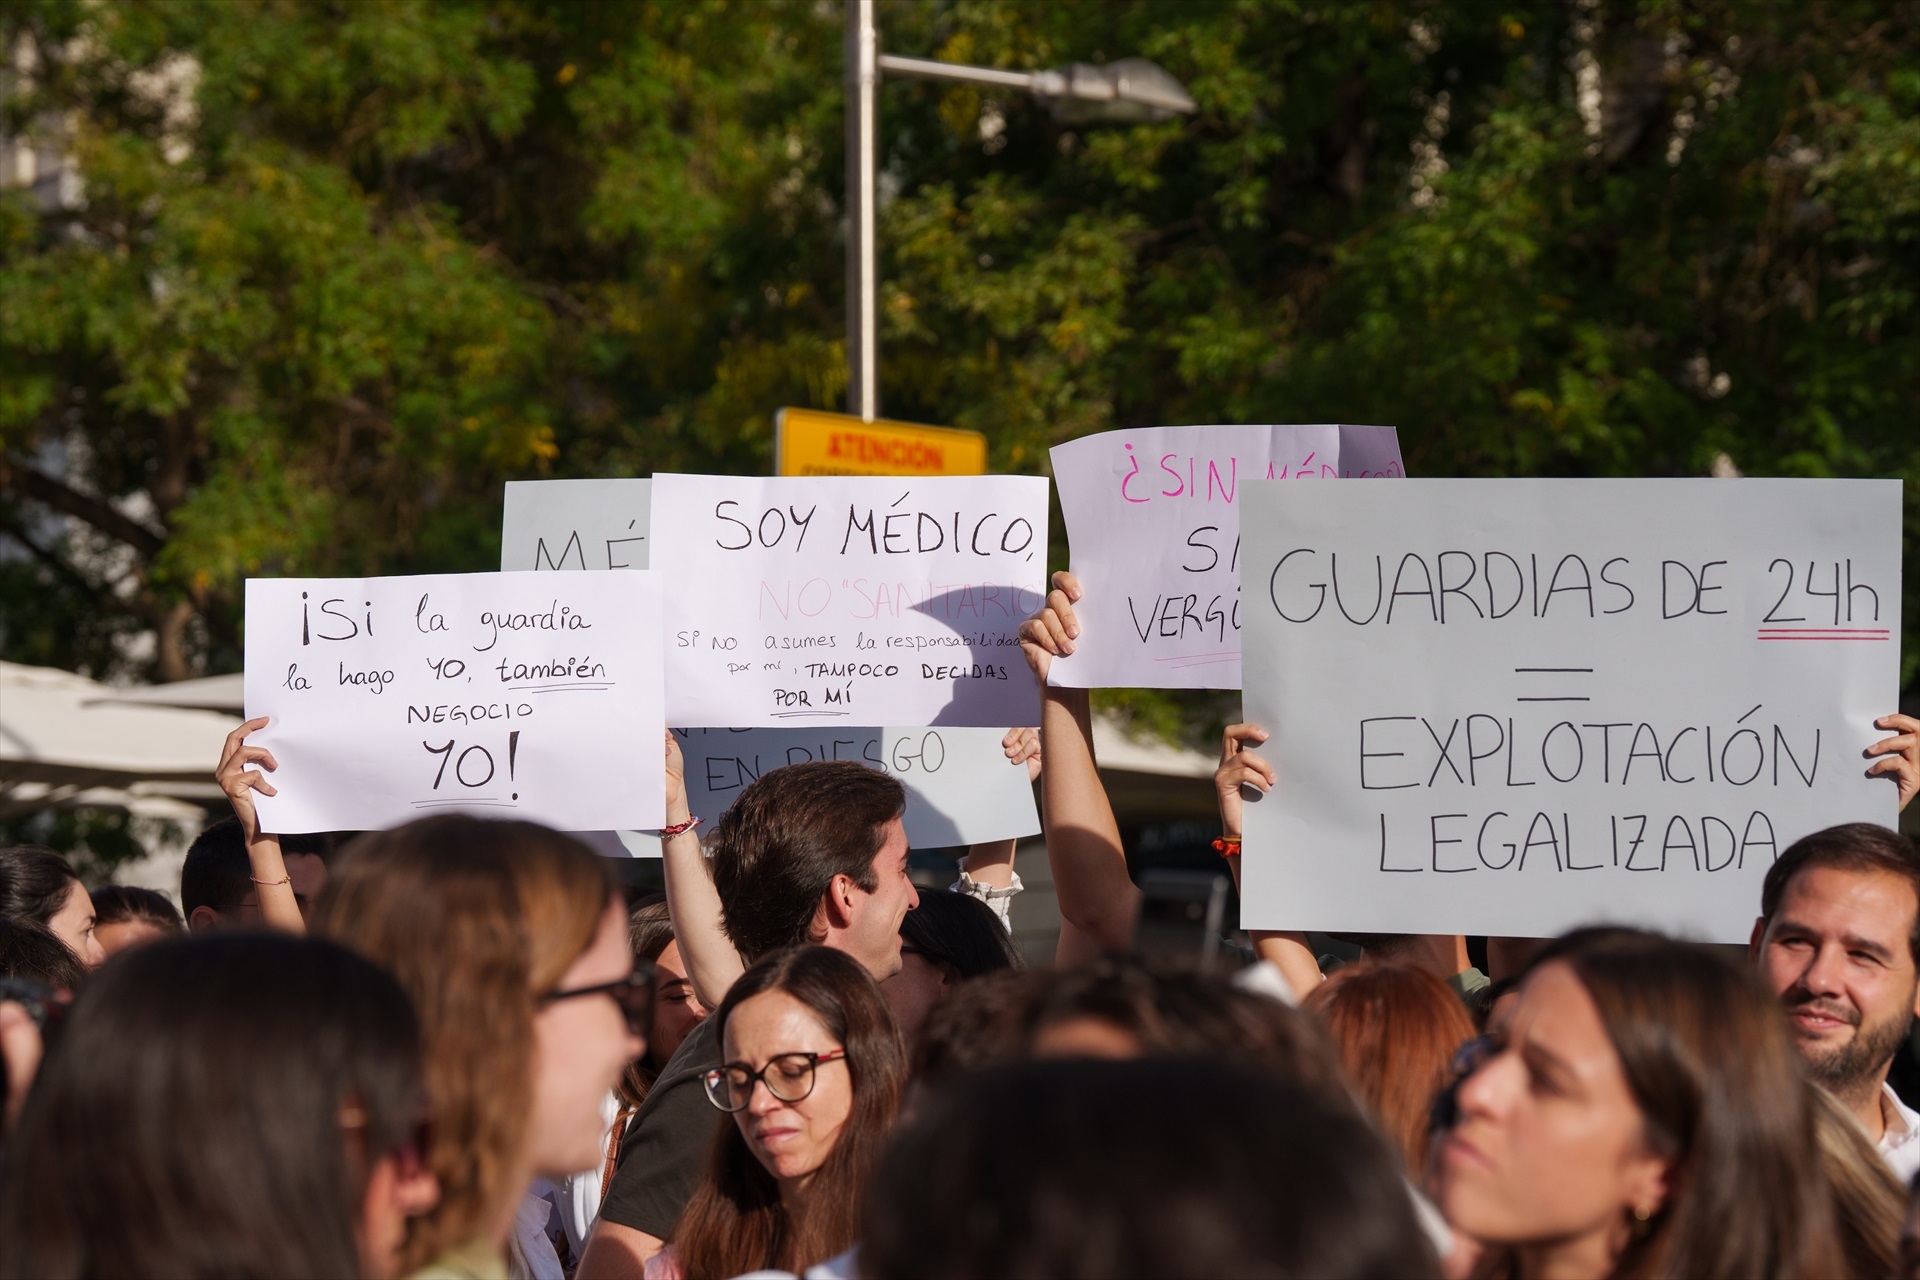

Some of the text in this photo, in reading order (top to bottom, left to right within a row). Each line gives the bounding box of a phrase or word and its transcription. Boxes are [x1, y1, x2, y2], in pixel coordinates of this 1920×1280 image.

[1121, 443, 1236, 504] ¿SIN
[715, 490, 1034, 562] SOY MÉDICO,
[759, 577, 832, 621] NO
[1270, 548, 1879, 625] GUARDIAS DE 24h
[416, 592, 450, 634] la
[472, 599, 592, 652] guardia
[712, 636, 738, 650] NO
[764, 635, 837, 650] asumes
[855, 631, 877, 651] la
[282, 663, 313, 691] la
[339, 661, 395, 695] hago
[495, 656, 607, 683] también
[726, 662, 751, 676] por
[804, 663, 898, 679] TAMPOCO
[922, 662, 1009, 681] DECIDAS
[773, 680, 853, 707] POR MÍ
[407, 703, 534, 726] NEGOCIO
[422, 730, 522, 801] YO!
[706, 755, 760, 791] EN
[1360, 704, 1820, 790] EXPLOTACIÓN
[1379, 811, 1779, 873] LEGALIZADA
